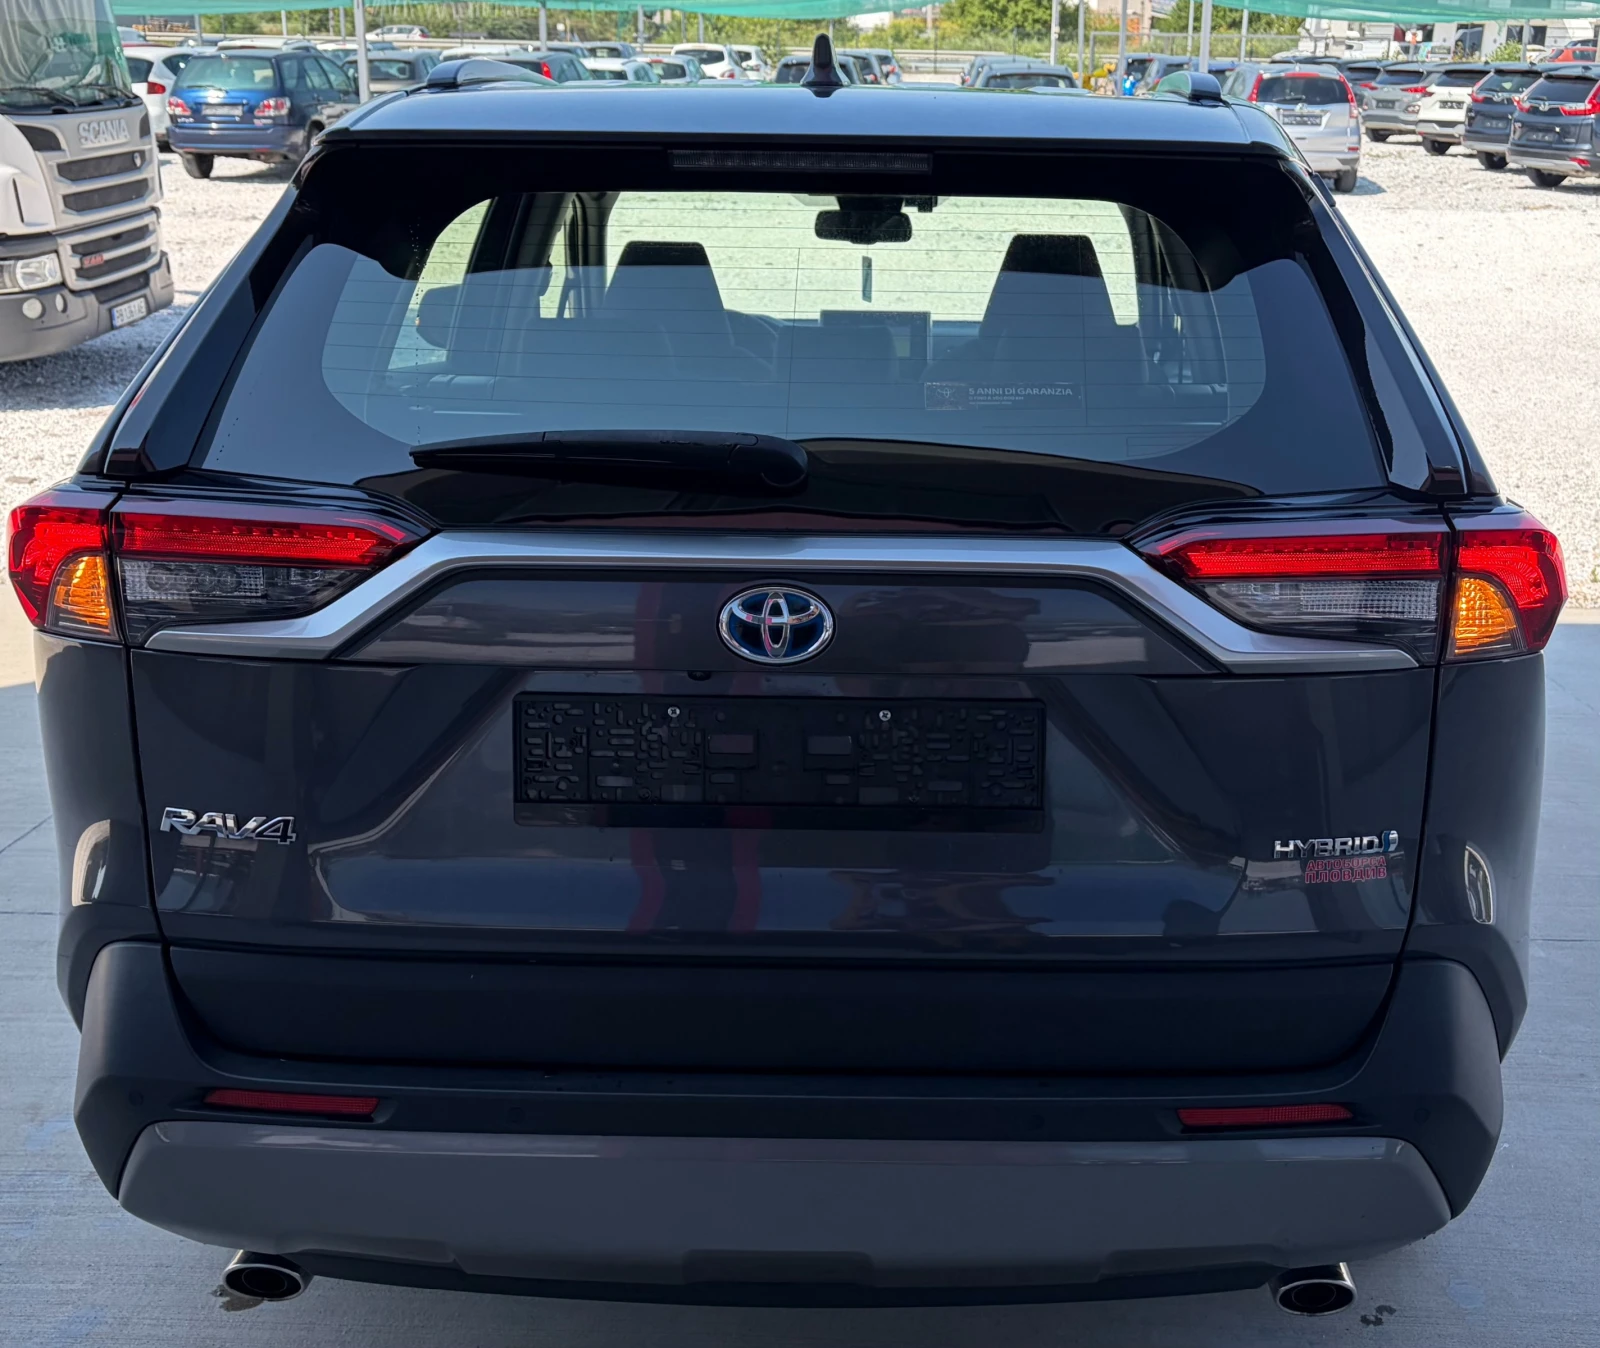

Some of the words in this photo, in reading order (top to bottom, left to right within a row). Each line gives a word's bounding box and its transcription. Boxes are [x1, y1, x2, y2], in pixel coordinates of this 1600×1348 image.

[78, 118, 130, 145] SCANIA
[969, 387, 975, 395] 5
[977, 387, 1003, 395] ANNI
[1005, 387, 1016, 395] DI
[1017, 387, 1073, 396] GARANZIA
[160, 807, 296, 844] RAV4
[1274, 836, 1382, 859] HYBRID
[1306, 856, 1387, 870] АВТОБОРСА
[1305, 867, 1387, 883] ПЛОВДИВ
